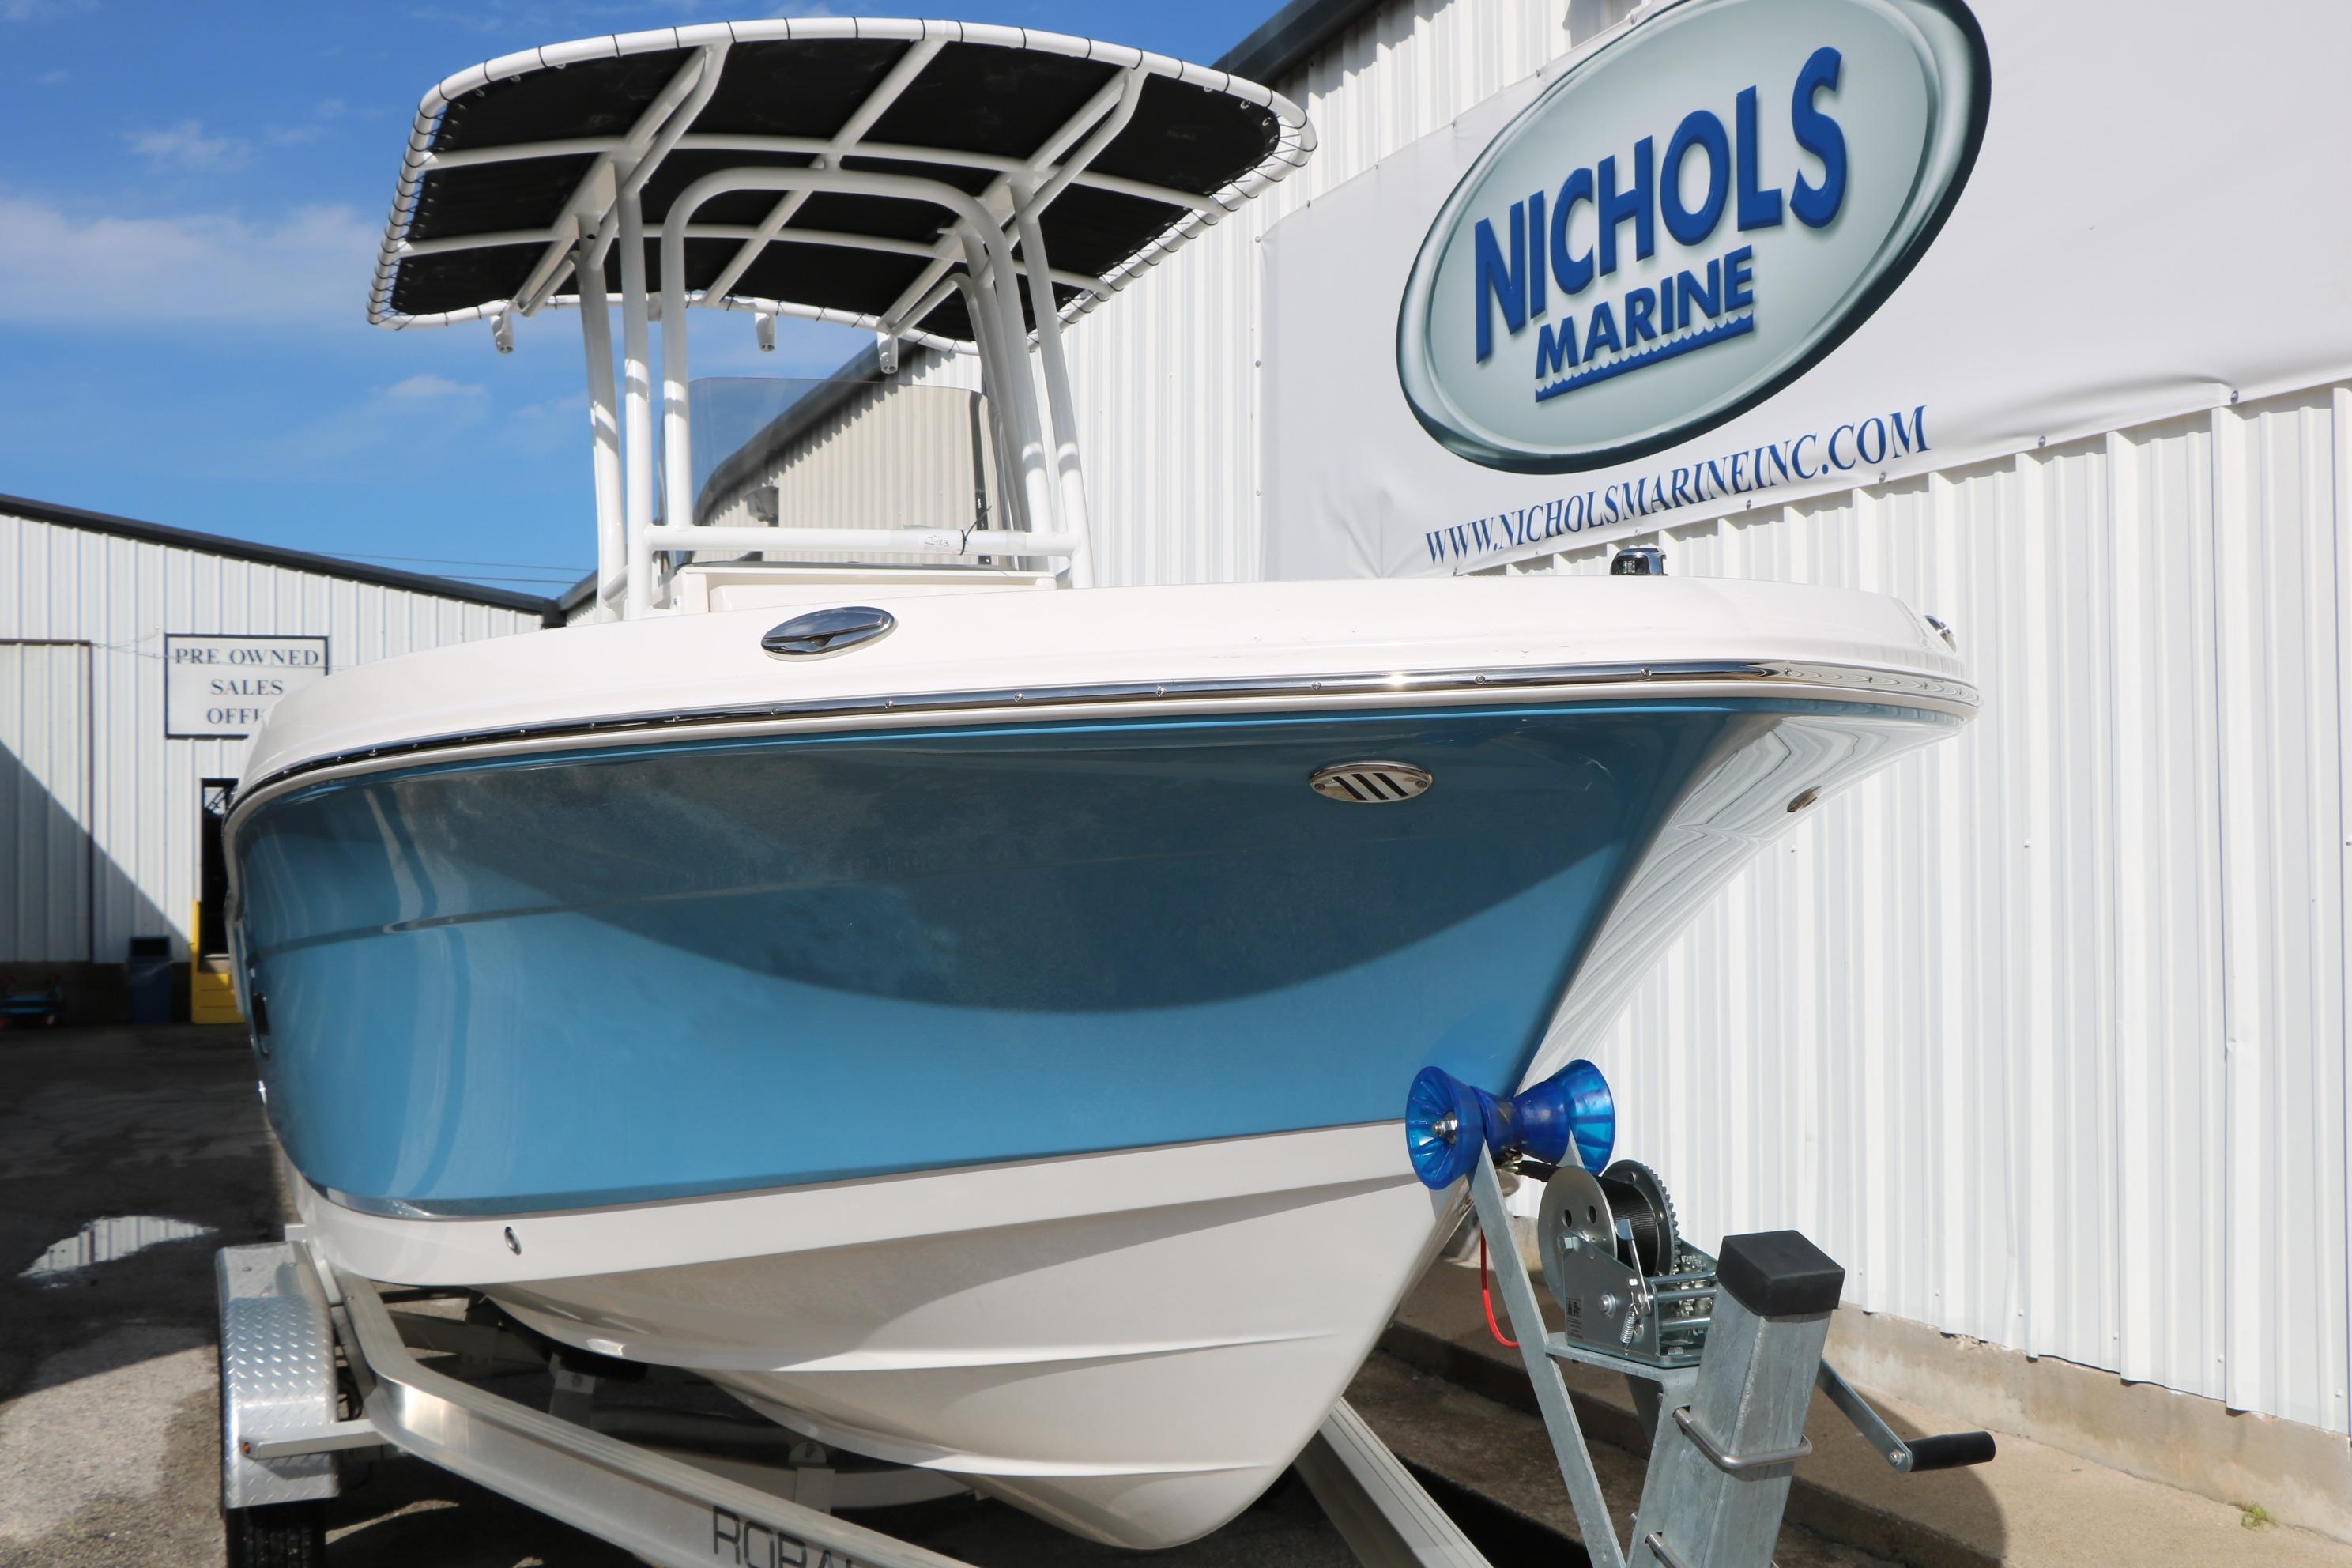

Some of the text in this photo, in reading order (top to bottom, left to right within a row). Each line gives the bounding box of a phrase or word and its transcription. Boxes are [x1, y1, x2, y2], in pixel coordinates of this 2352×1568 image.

[1474, 46, 1849, 365] NICHOLS
[1535, 243, 1755, 380] MARINE
[1426, 405, 1932, 566] WWW.NICHOLSMARINEINC.COM
[175, 648, 319, 666] PRE OWNED
[210, 679, 284, 695] SALES
[206, 707, 265, 725] OFFI
